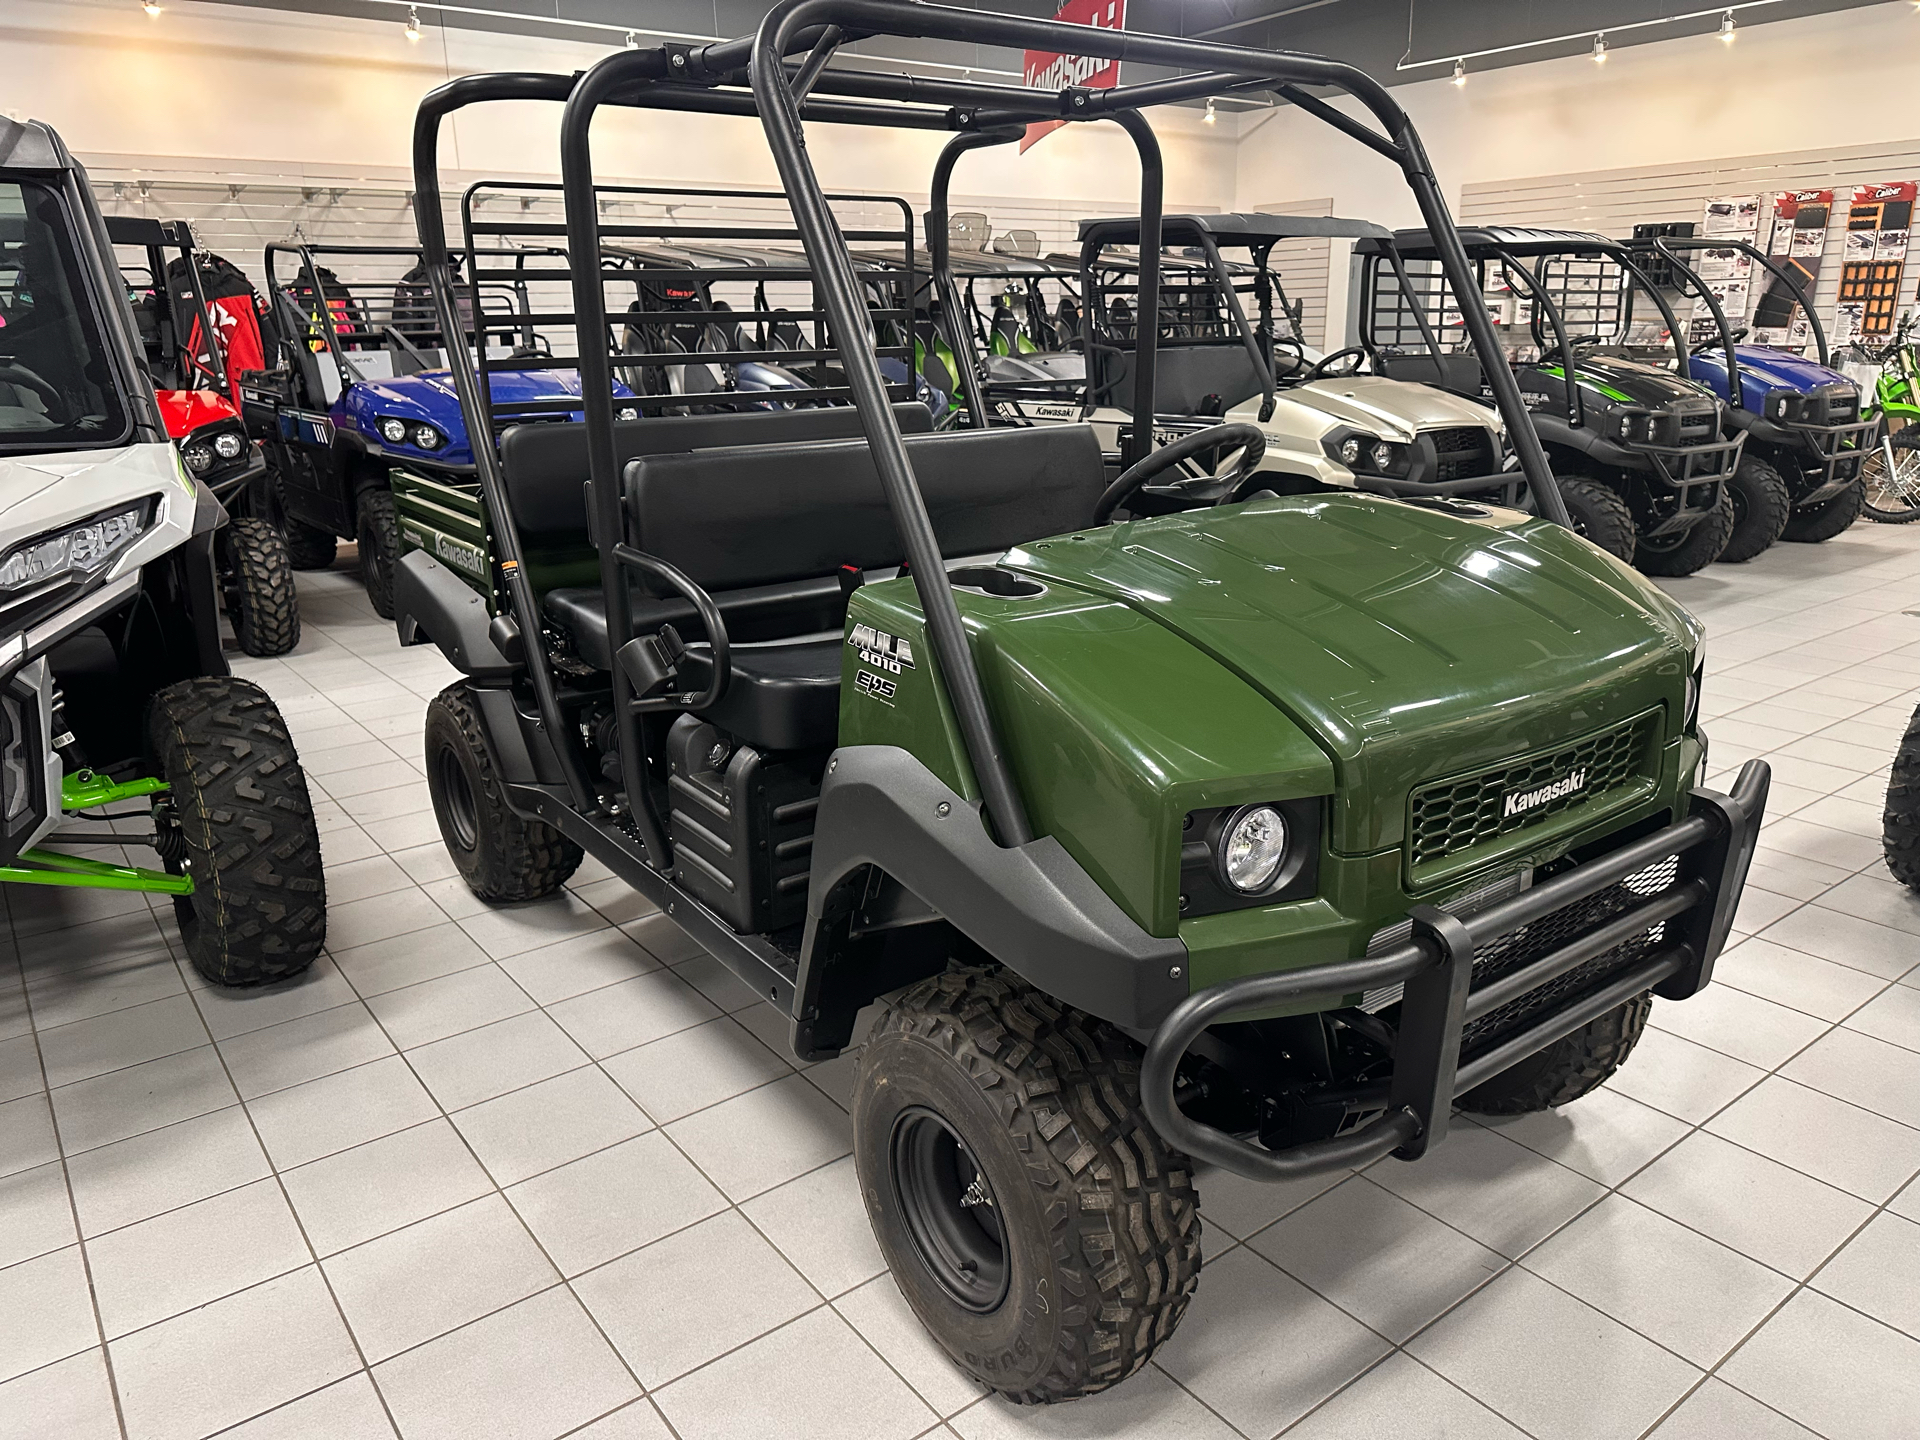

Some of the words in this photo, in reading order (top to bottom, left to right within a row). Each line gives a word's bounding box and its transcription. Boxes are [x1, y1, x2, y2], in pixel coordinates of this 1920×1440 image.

[1796, 191, 1820, 202] Caliber
[1876, 186, 1902, 198] Caliber
[1035, 406, 1075, 417] Kawasaki
[434, 531, 485, 575] Kawasaki
[847, 622, 916, 670] MULE
[859, 649, 902, 676] 4010
[855, 668, 897, 698] EPS
[1503, 767, 1586, 818] Kawasaki
